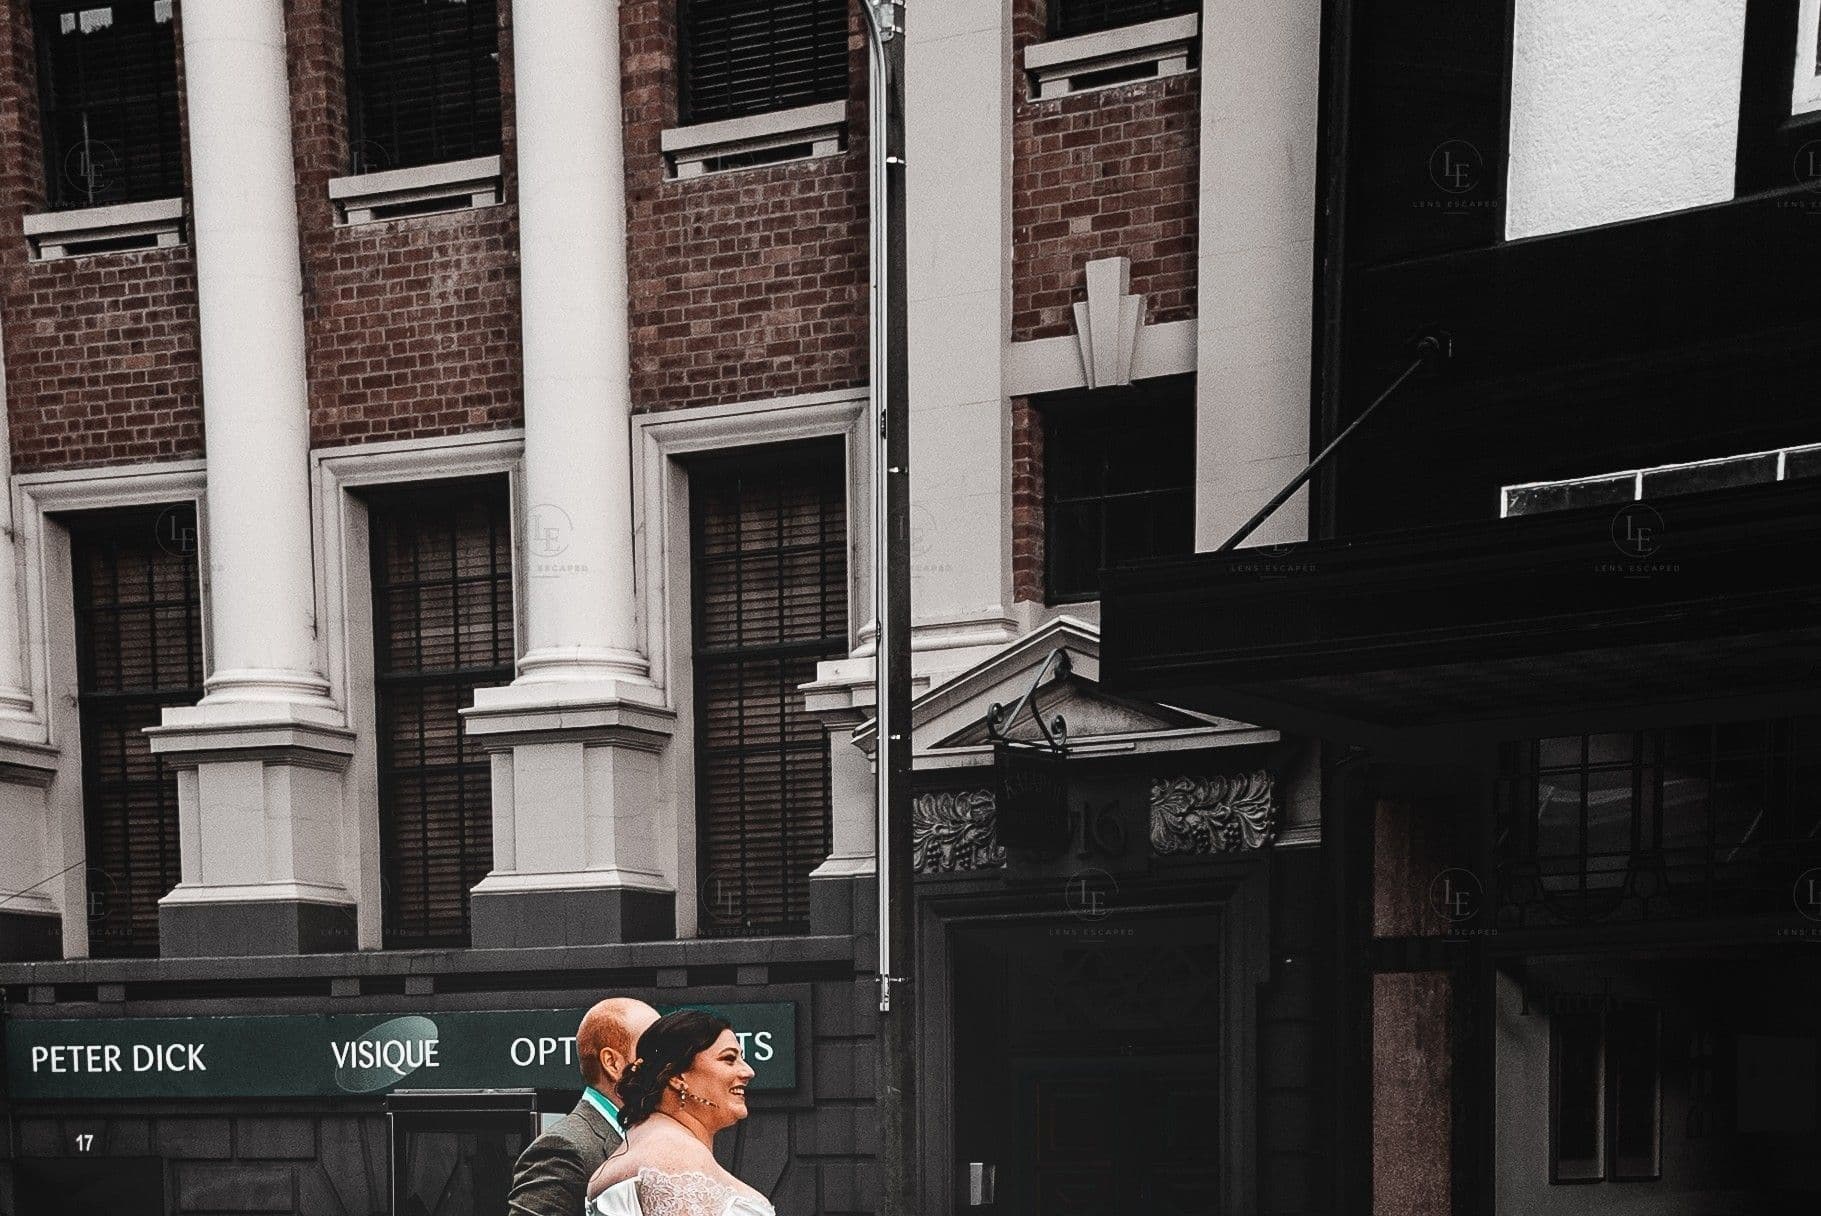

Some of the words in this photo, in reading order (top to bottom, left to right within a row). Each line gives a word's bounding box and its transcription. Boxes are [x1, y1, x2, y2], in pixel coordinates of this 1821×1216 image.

[31, 1044, 123, 1074] PETER
[132, 1043, 207, 1073] DICK
[330, 1039, 440, 1076] VISIQUE
[75, 1134, 94, 1152] 17
